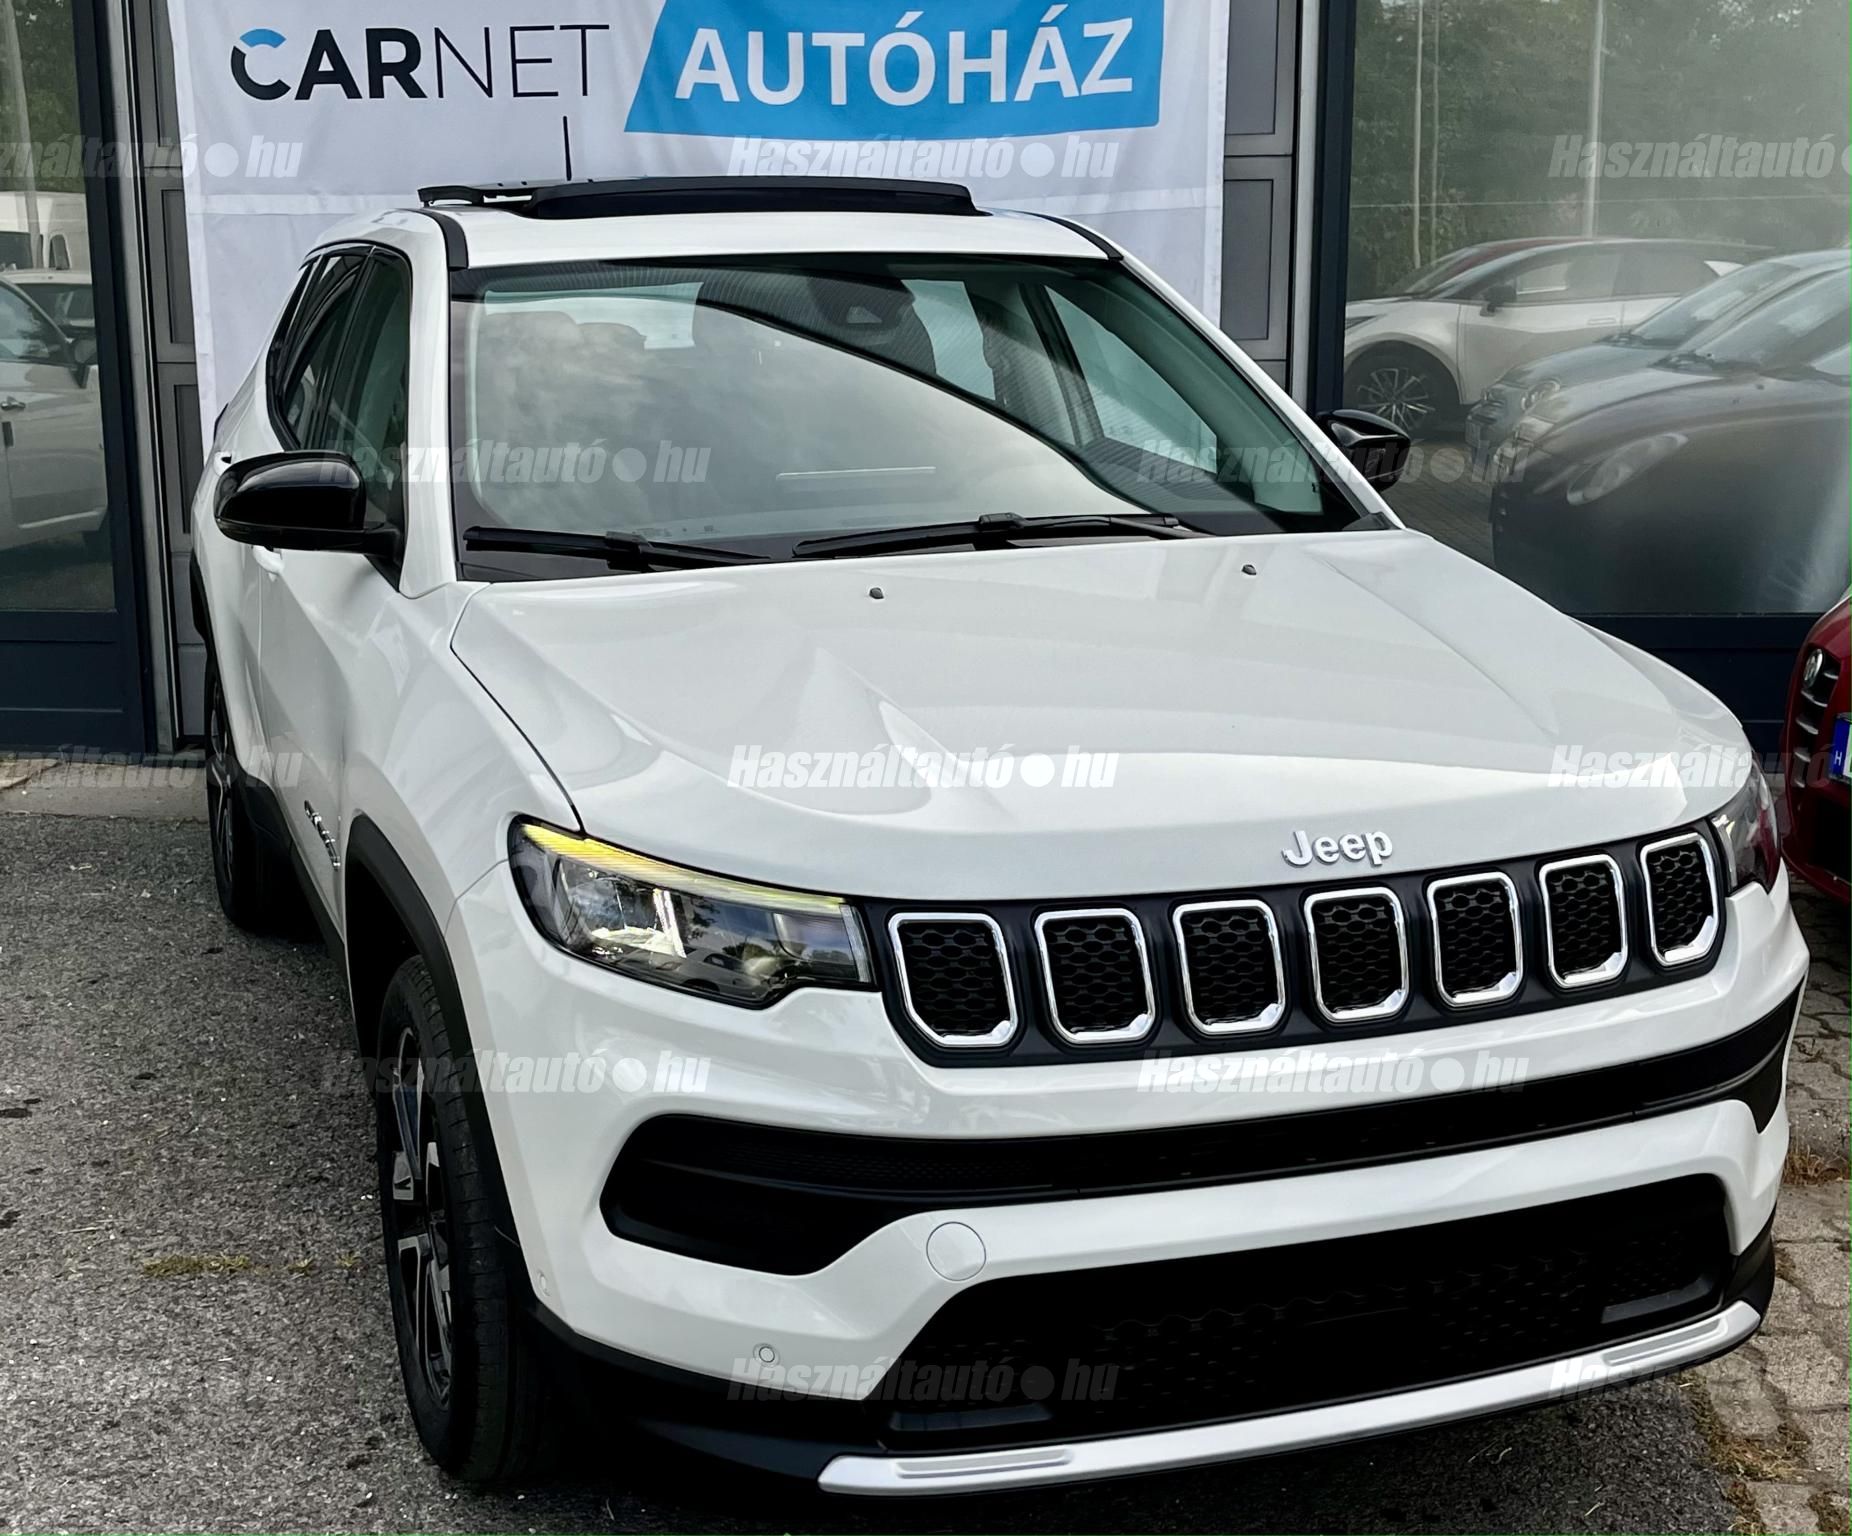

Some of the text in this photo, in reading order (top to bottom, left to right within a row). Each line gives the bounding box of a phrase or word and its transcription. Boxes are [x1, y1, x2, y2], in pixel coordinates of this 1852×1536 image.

[231, 4, 1133, 105] CARNET AUTÓHÁZ
[1281, 830, 1392, 868] Jeep
